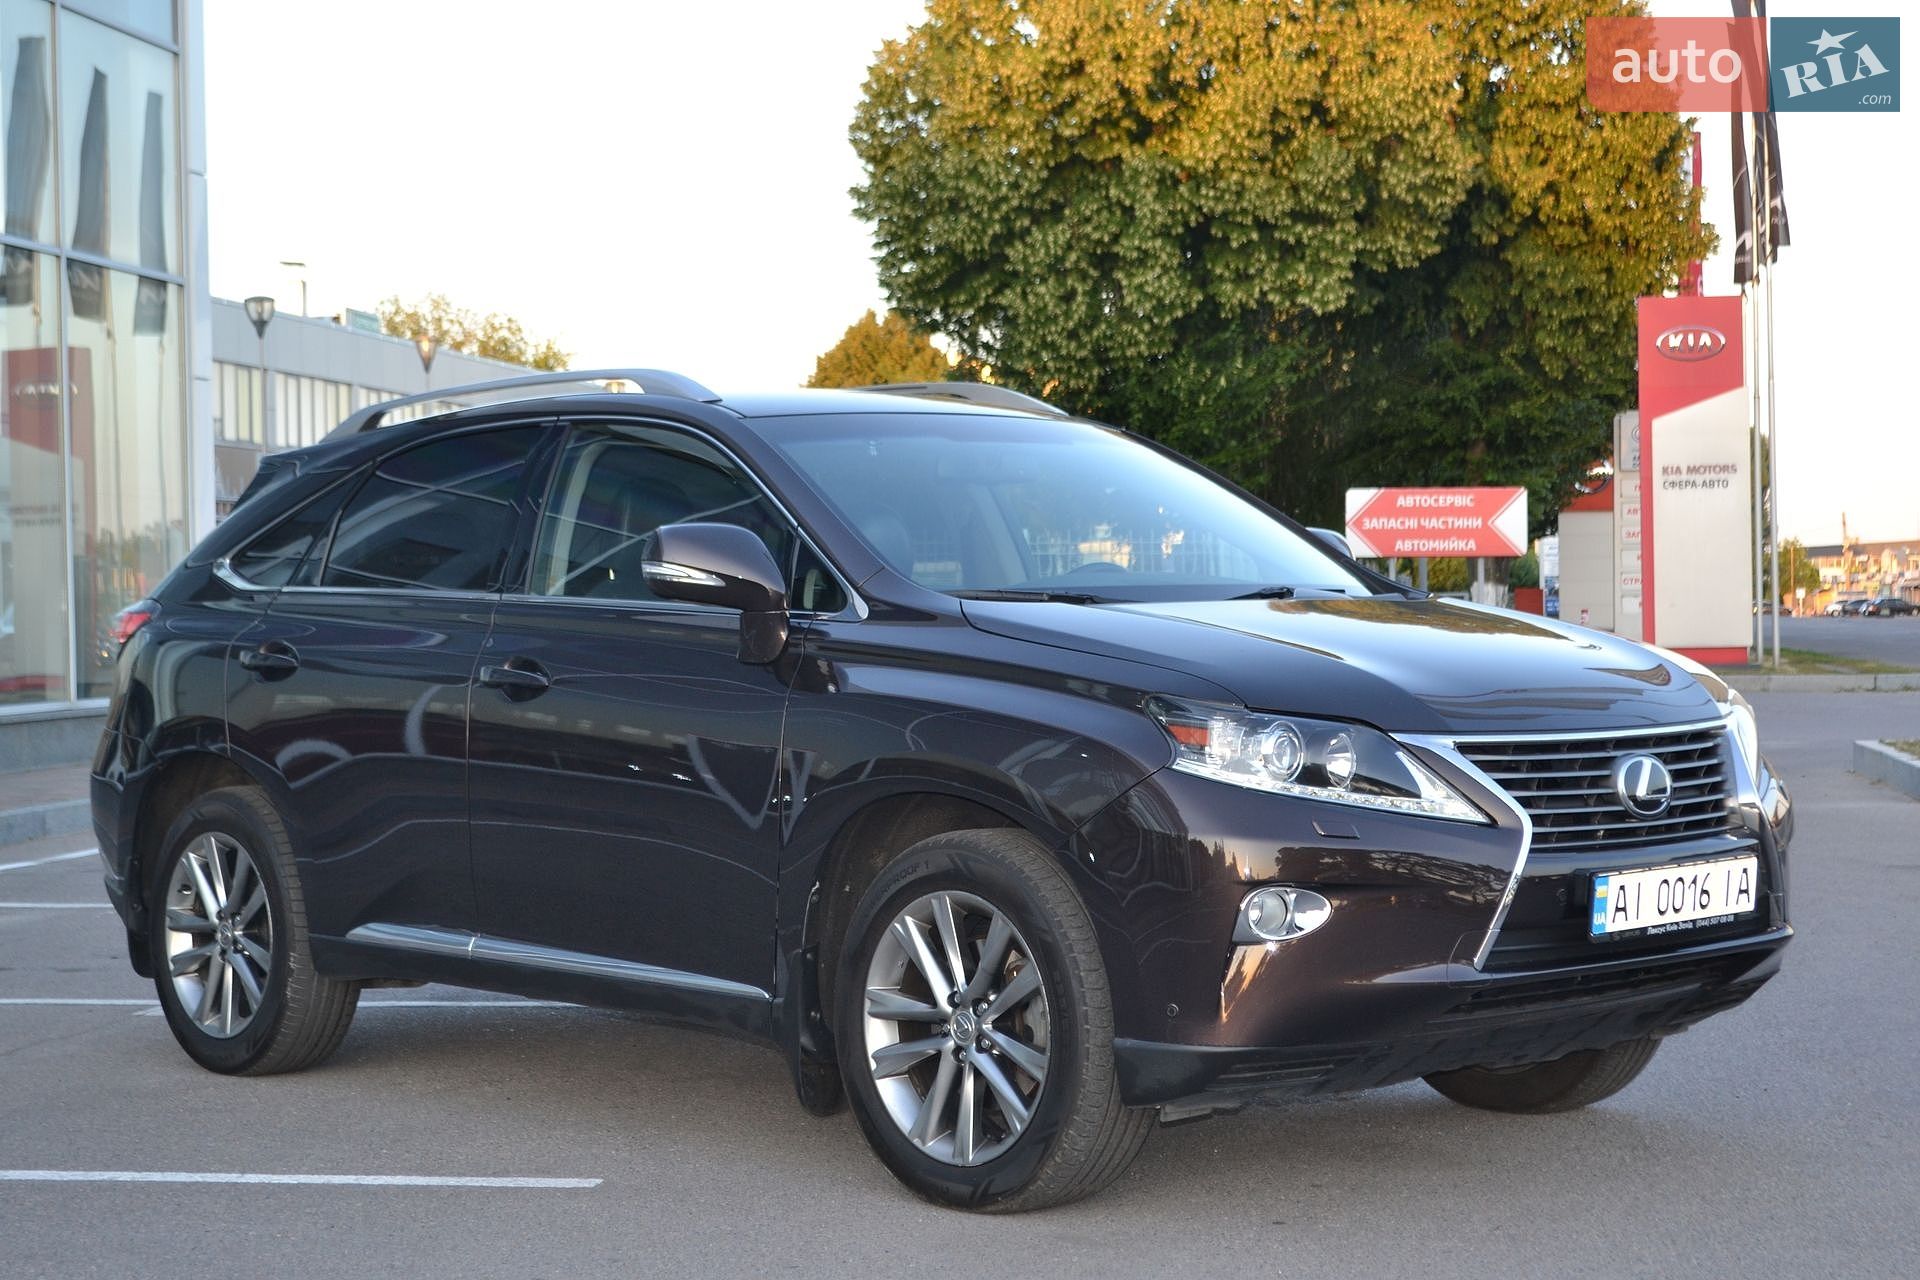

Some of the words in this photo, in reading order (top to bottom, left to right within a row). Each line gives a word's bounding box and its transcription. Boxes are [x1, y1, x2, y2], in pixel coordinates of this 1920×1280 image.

[1668, 332, 1712, 352] KIA
[1662, 464, 1682, 476] KIA
[1686, 463, 1737, 475] MOTORS
[1662, 479, 1729, 490] СФЕРА-АВТО
[1396, 495, 1475, 508] АВТОСЕРВІС
[1362, 517, 1418, 530] ЗАПАСНІ
[1420, 517, 1483, 529] ЧАСТИНИ
[1394, 536, 1477, 552] АВТОМИЙКА
[1612, 882, 1641, 923] AI
[1657, 873, 1711, 916] 0016
[1725, 867, 1751, 907] IA
[1594, 911, 1607, 925] UA
